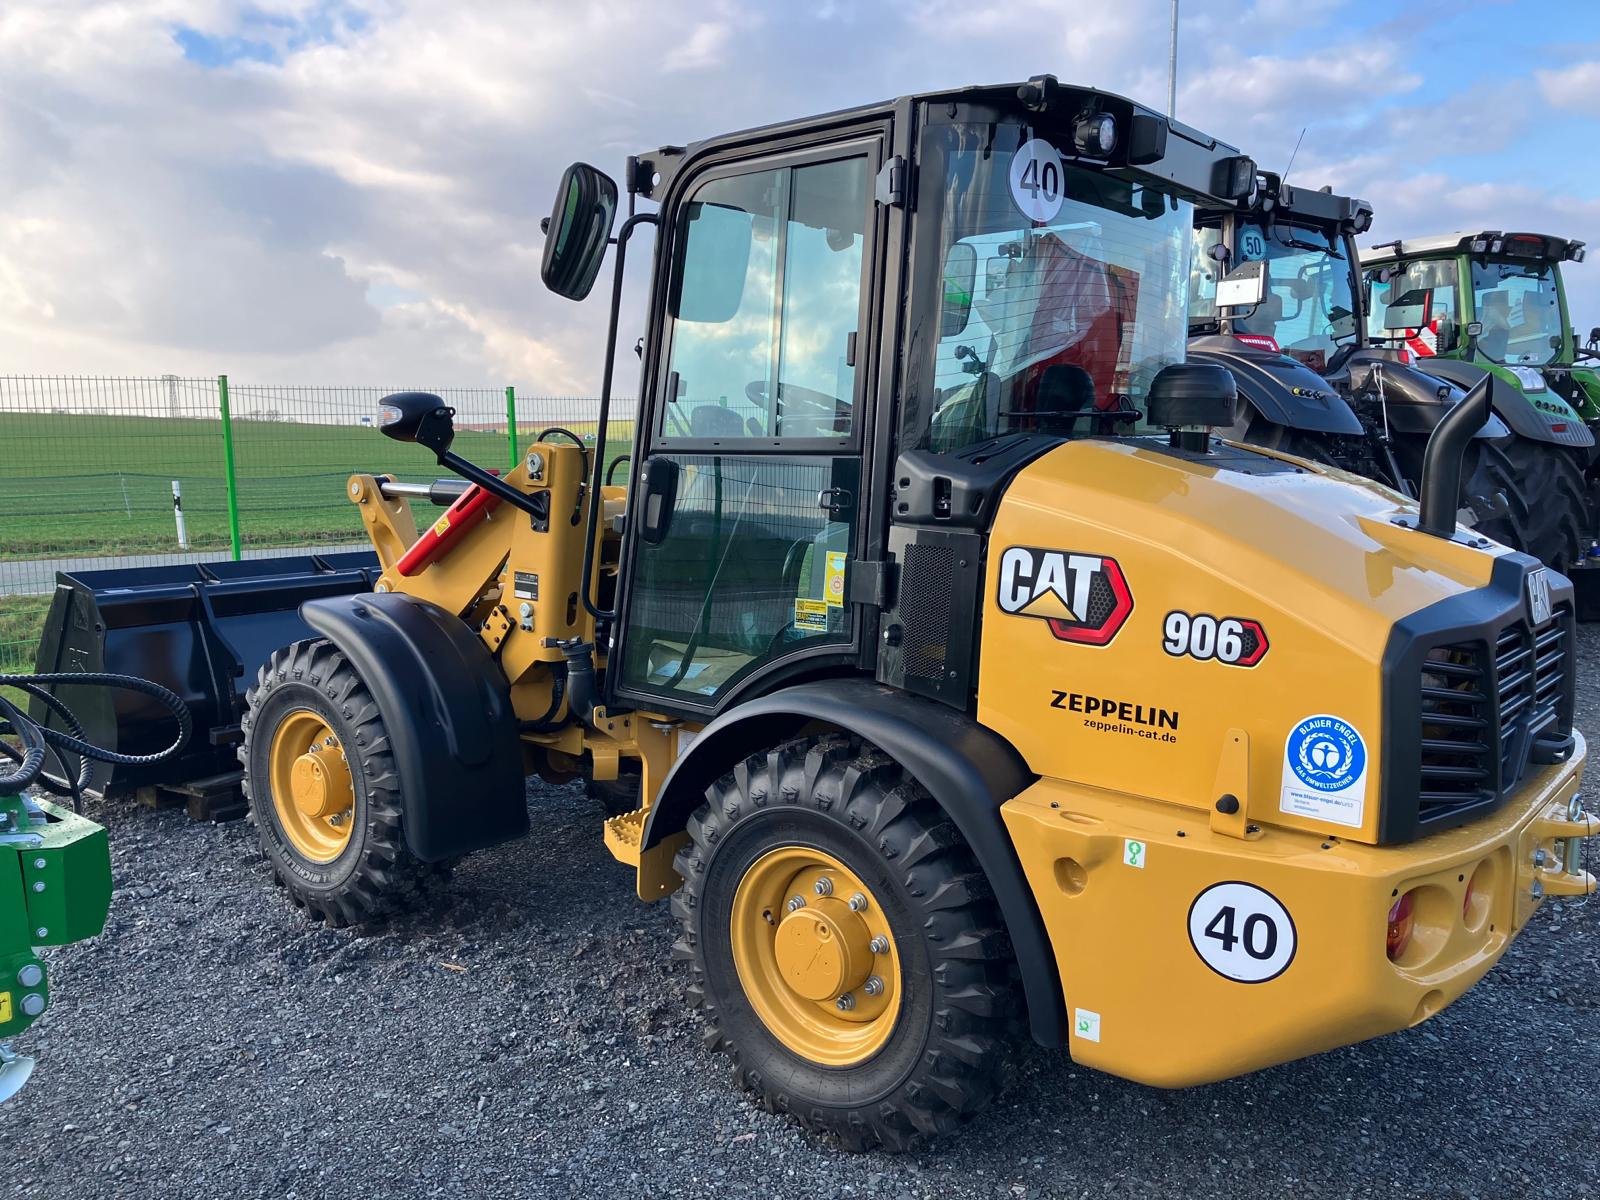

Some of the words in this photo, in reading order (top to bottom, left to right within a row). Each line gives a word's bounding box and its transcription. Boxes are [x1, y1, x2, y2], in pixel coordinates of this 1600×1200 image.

[1020, 158, 1059, 203] 40
[1245, 236, 1262, 256] 50
[1000, 547, 1102, 623] CAT
[1164, 612, 1244, 662] 906
[1050, 690, 1180, 730] ZEPPELIN
[1083, 719, 1178, 744] zeppelin-cat.de
[1299, 720, 1332, 735] BLAUER
[1334, 723, 1358, 745] ENGEL
[1296, 765, 1307, 778] DAS
[1305, 774, 1353, 789] UMWELTZEICHEN
[281, 851, 321, 882] MICHELIN
[1204, 905, 1278, 960] 40
